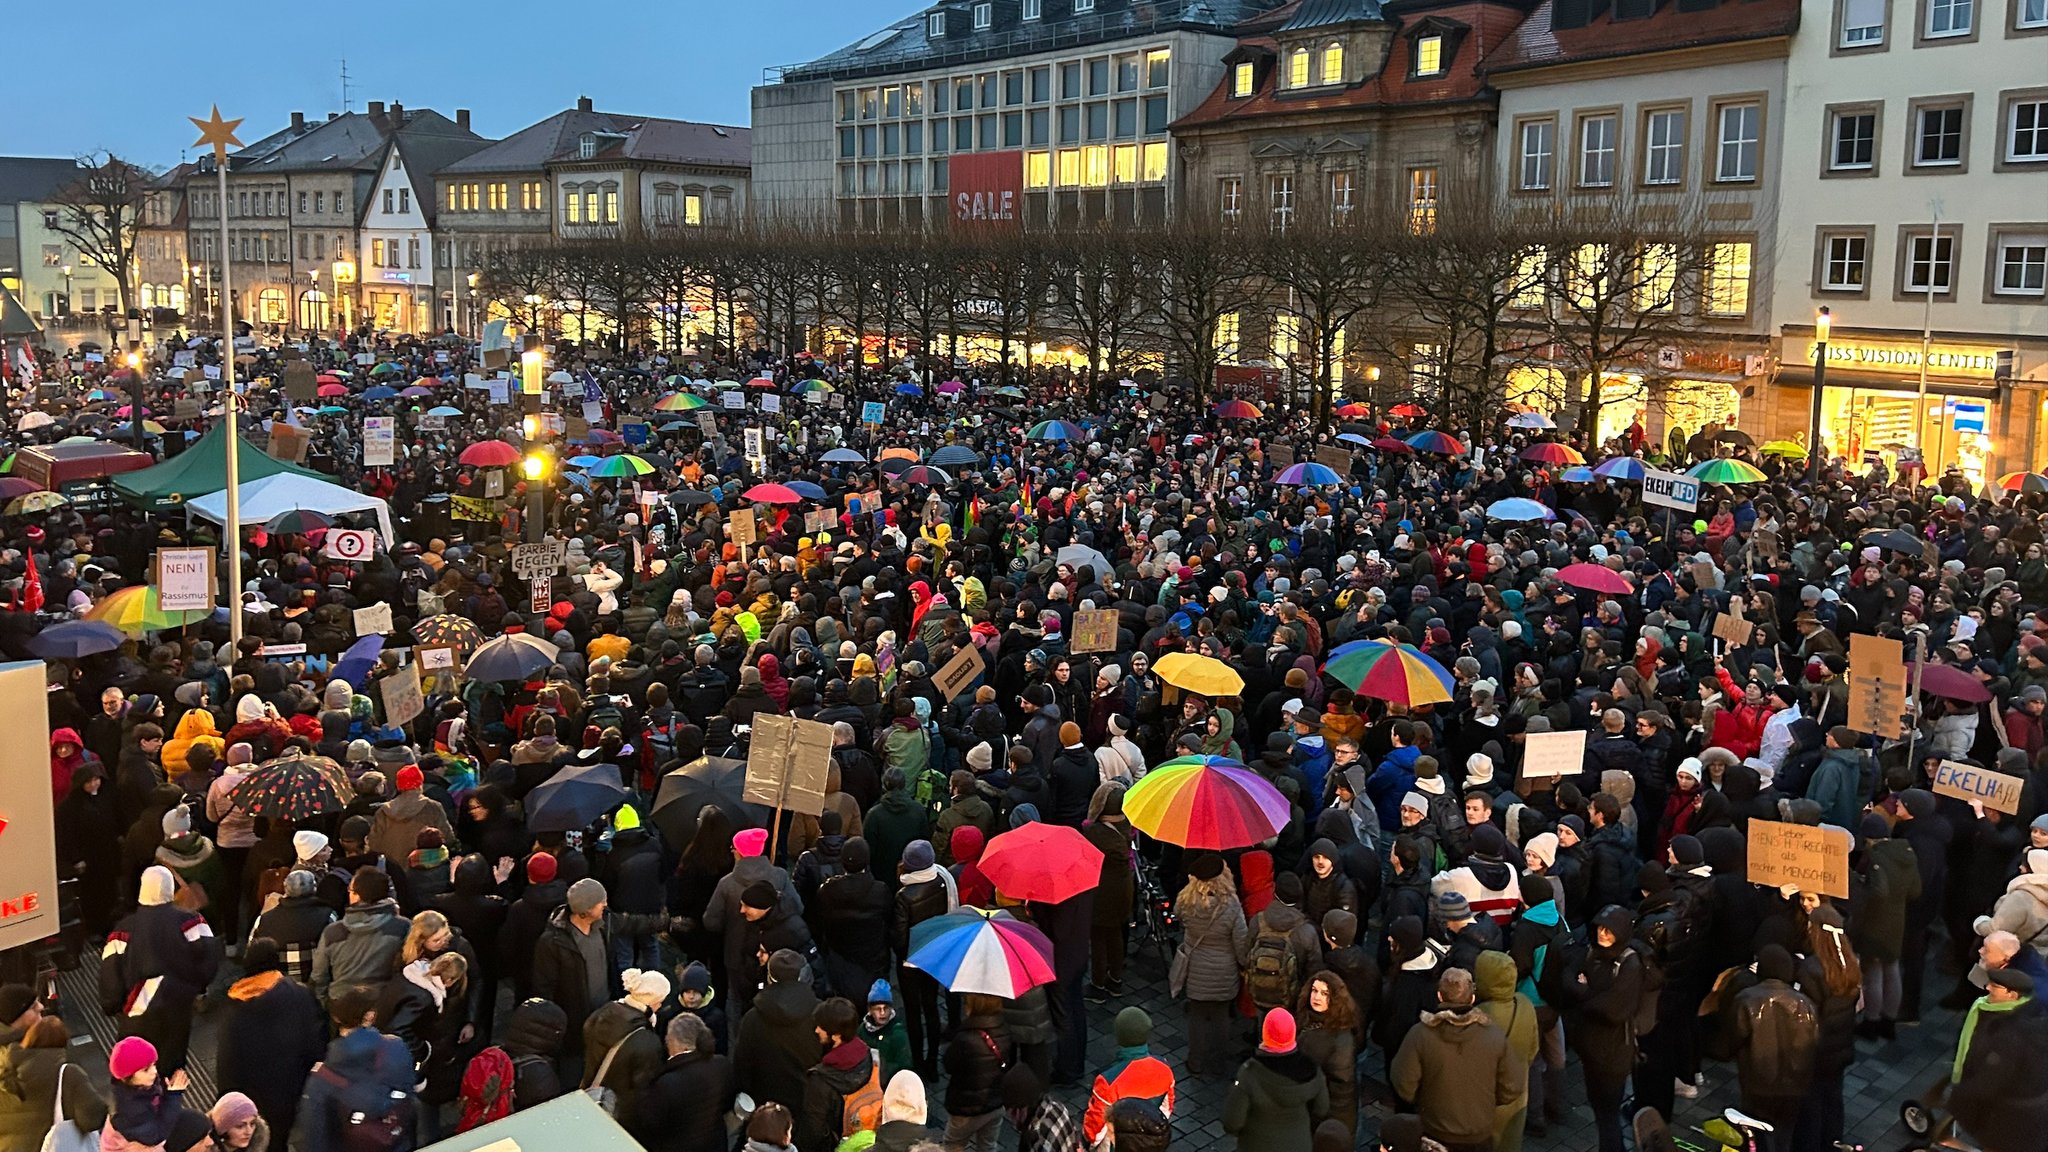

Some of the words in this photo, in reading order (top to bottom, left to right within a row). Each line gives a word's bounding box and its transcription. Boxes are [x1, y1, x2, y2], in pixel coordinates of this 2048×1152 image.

[957, 190, 1013, 220] SALE
[1810, 346, 1852, 361] ZISS
[1861, 348, 1919, 366] VISION
[1926, 352, 1994, 370] CENTER
[519, 543, 557, 557] BARBIE
[514, 553, 561, 569] GEGEN
[166, 563, 196, 574] NEIN
[534, 578, 549, 588] WC
[161, 591, 208, 600] Rassismus
[1780, 850, 1798, 861] als
[1750, 861, 1776, 874] rechte
[1782, 865, 1837, 884] MENSCHEN
